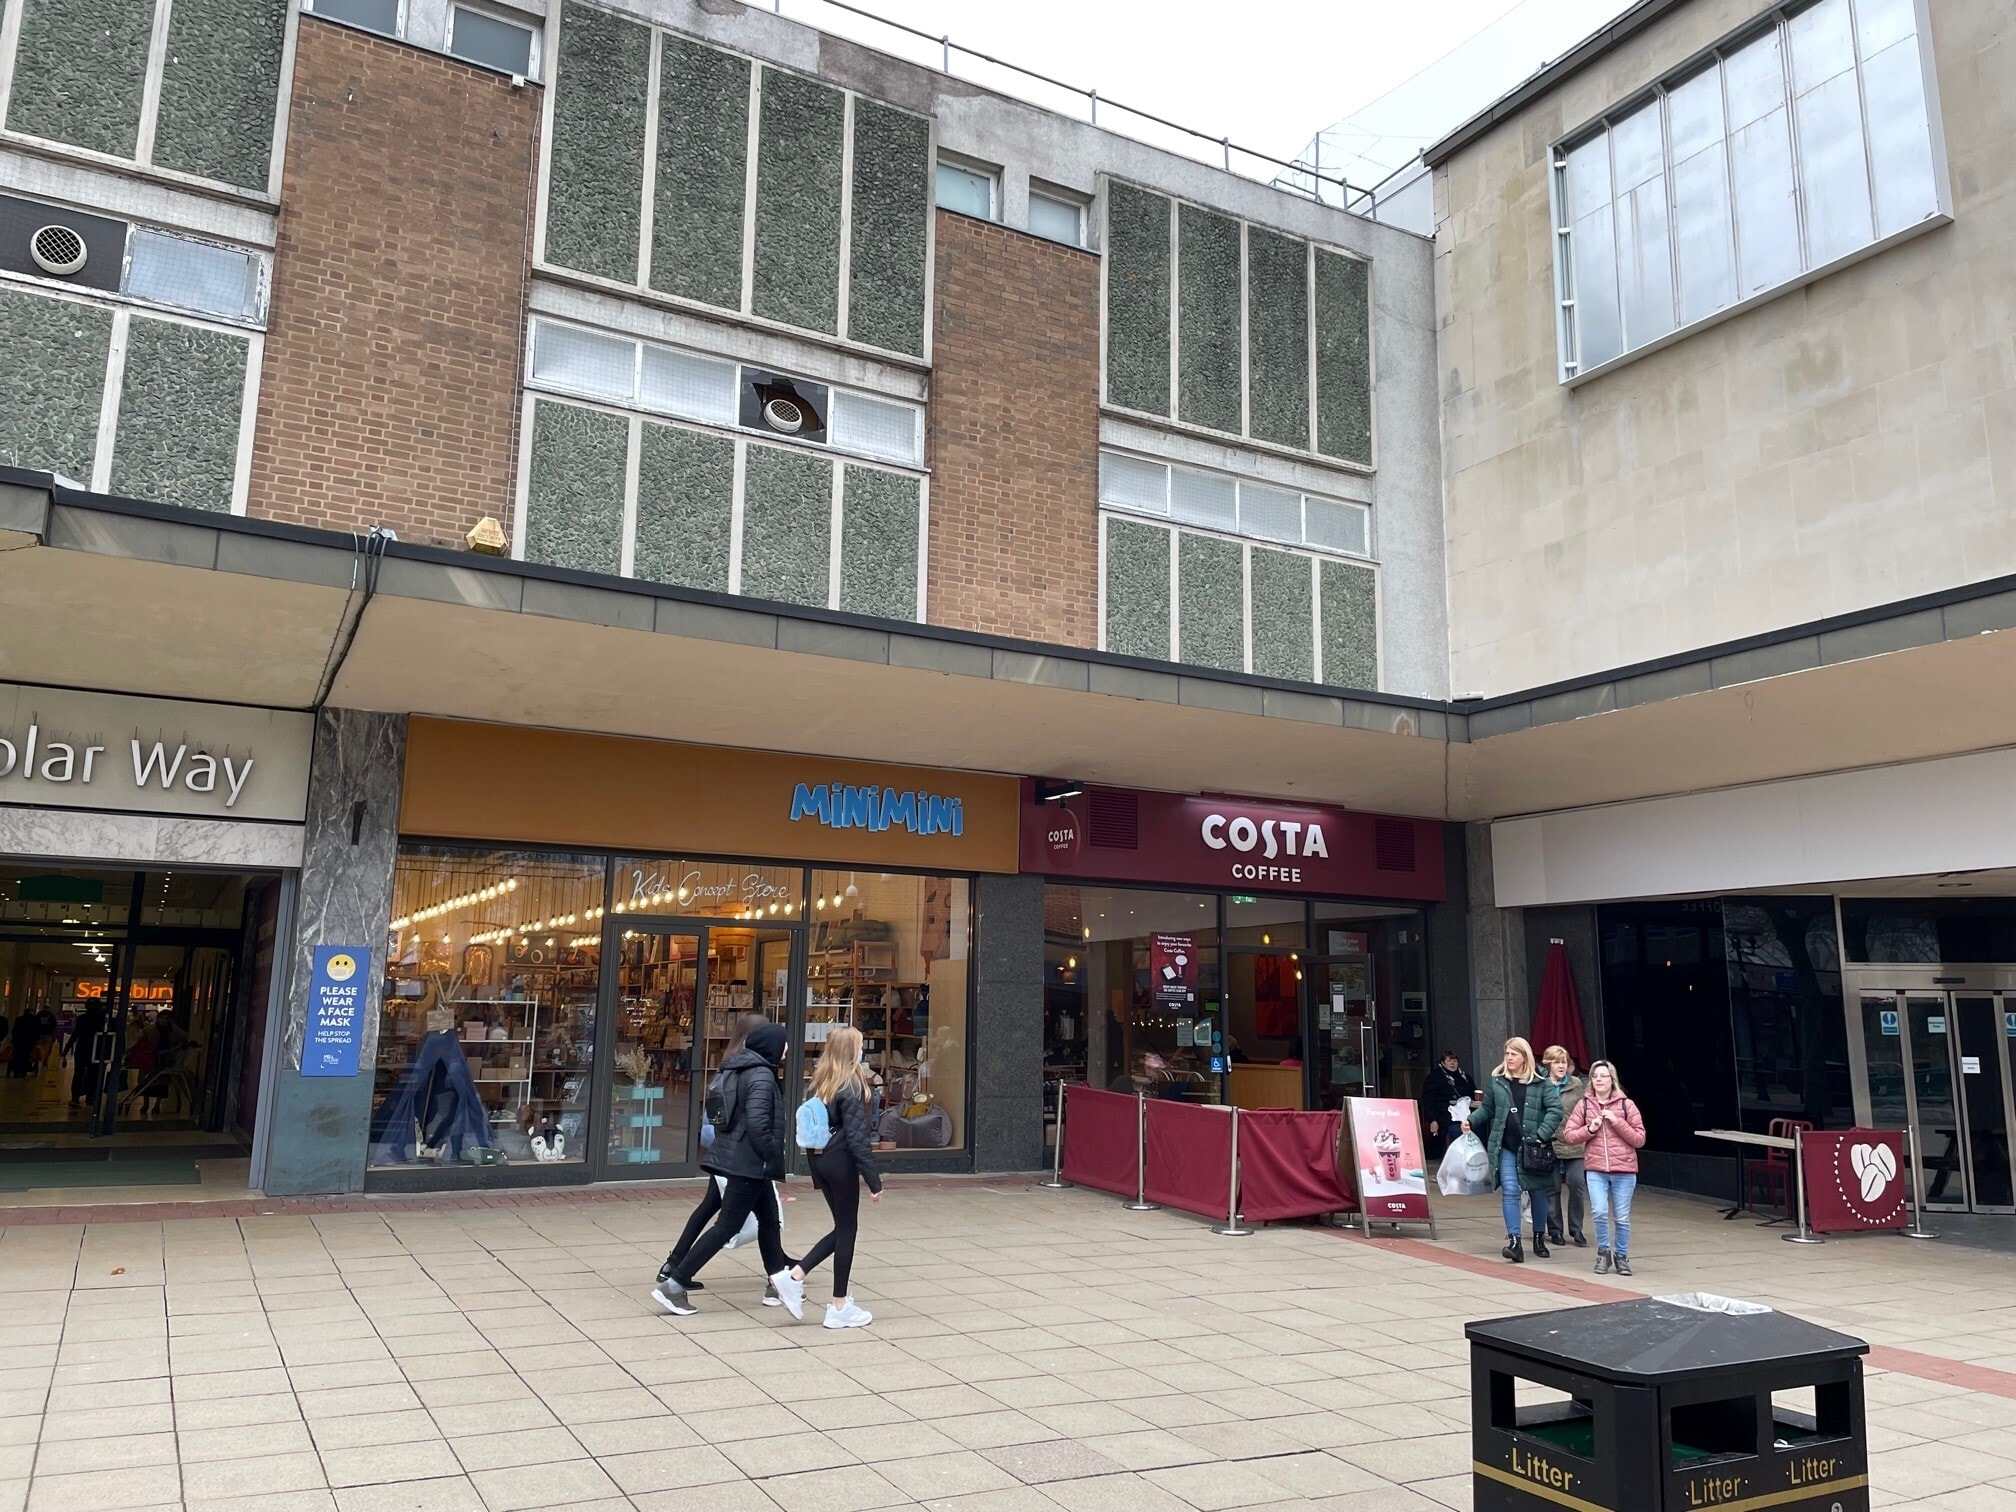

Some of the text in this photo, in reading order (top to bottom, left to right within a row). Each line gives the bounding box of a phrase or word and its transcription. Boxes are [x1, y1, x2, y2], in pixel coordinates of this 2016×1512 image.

[130, 739, 254, 807] Way
[1048, 828, 1074, 842] COSTA
[1201, 814, 1329, 860] COSTA
[1231, 863, 1302, 883] COFFEE
[632, 870, 791, 907] Kids Concept Store
[76, 982, 173, 1001] Saibur
[320, 986, 358, 996] PLEASE
[322, 996, 353, 1006] WEAR
[317, 1007, 355, 1016] A FACE
[320, 1017, 351, 1027] MASK
[1512, 1447, 1574, 1491] Litter
[1790, 1456, 1836, 1485] Litter
[1690, 1477, 1741, 1505] Litter
